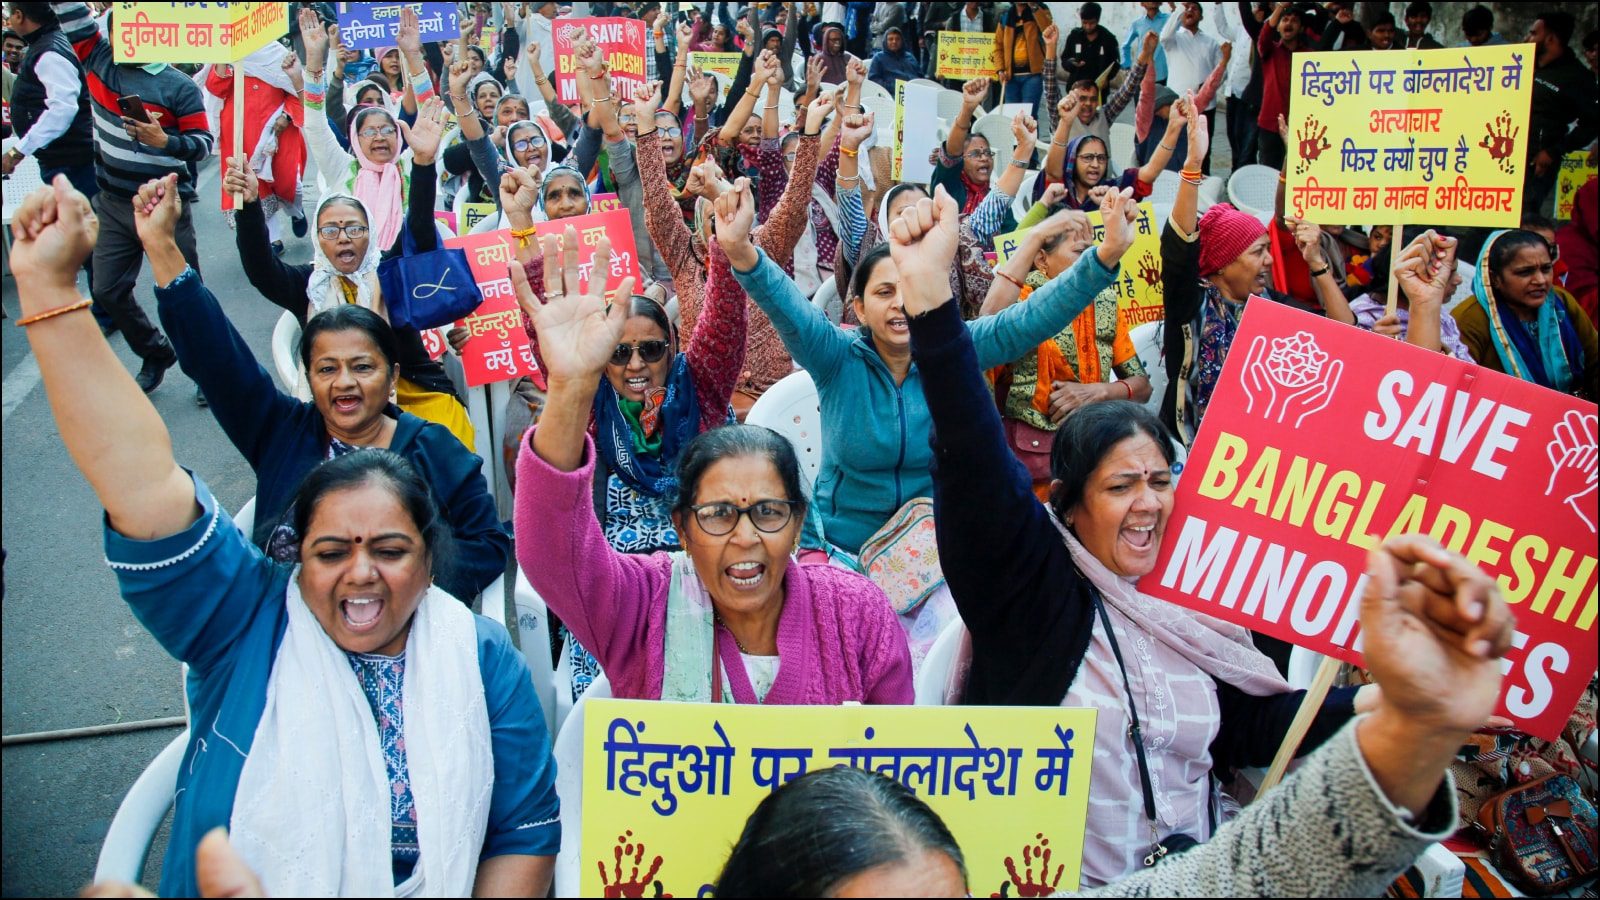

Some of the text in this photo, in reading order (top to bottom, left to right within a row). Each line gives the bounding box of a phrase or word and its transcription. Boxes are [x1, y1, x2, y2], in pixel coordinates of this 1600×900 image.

[121, 11, 179, 57] दुनिया
[186, 23, 213, 47] का
[219, 15, 249, 47] मानव
[341, 19, 386, 48] दुनिया
[590, 23, 624, 44] SAVE
[1301, 52, 1523, 106] हिंदुओ पर बांग्लादेश में
[1369, 108, 1443, 133] अत्याचार
[1340, 134, 1470, 182] फिर क्यों चुप है
[1292, 175, 1516, 220] दुनिया का मानव अधिकार
[1136, 209, 1152, 236] में
[477, 277, 515, 301] ानव
[1124, 270, 1136, 299] है
[1363, 369, 1532, 480] SAVE
[603, 717, 735, 817] हिंदुओ
[1034, 723, 1075, 796] में
